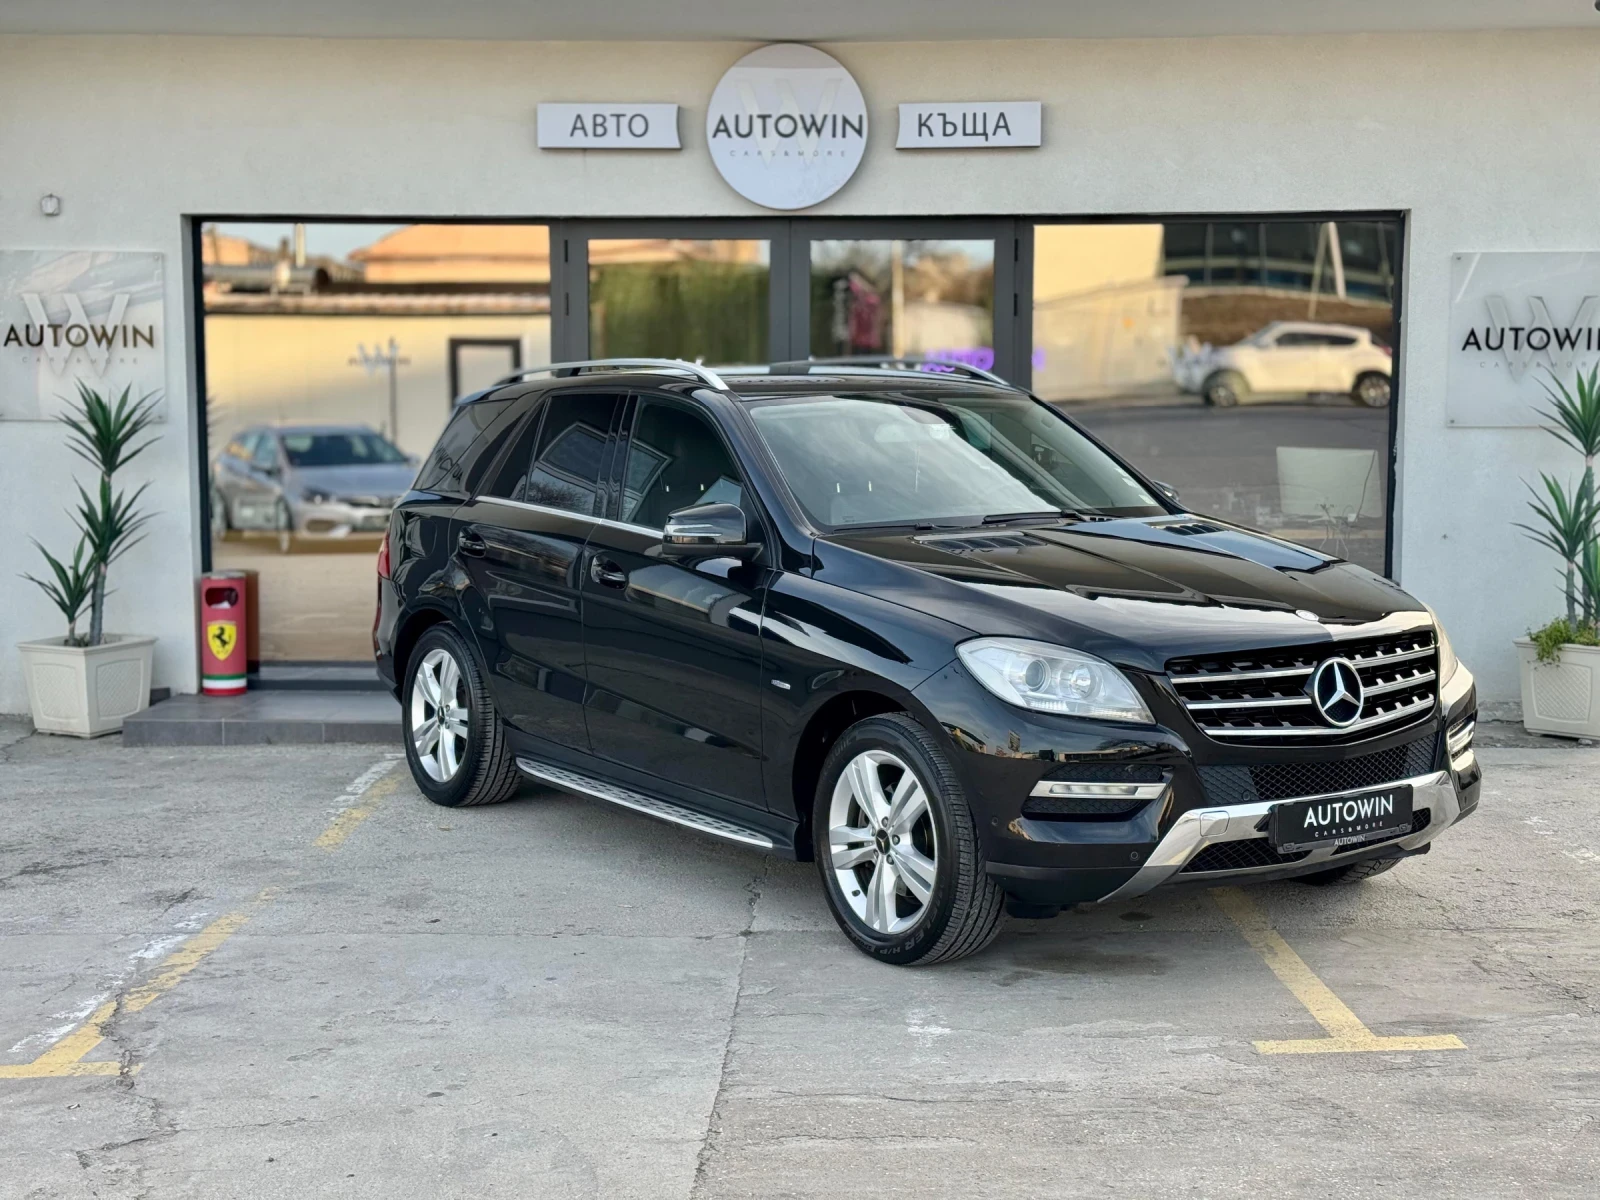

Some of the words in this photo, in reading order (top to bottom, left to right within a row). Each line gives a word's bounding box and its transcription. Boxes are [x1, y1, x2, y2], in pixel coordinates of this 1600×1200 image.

[569, 113, 649, 138] АВТО
[711, 113, 864, 139] AUTOWIN
[917, 111, 1012, 142] КЪЩА
[3, 324, 154, 347] AUTOWIN
[1461, 327, 1600, 351] AUTOWI
[1303, 794, 1393, 828] AUTOWIN
[1333, 834, 1366, 846] AUTOWIN
